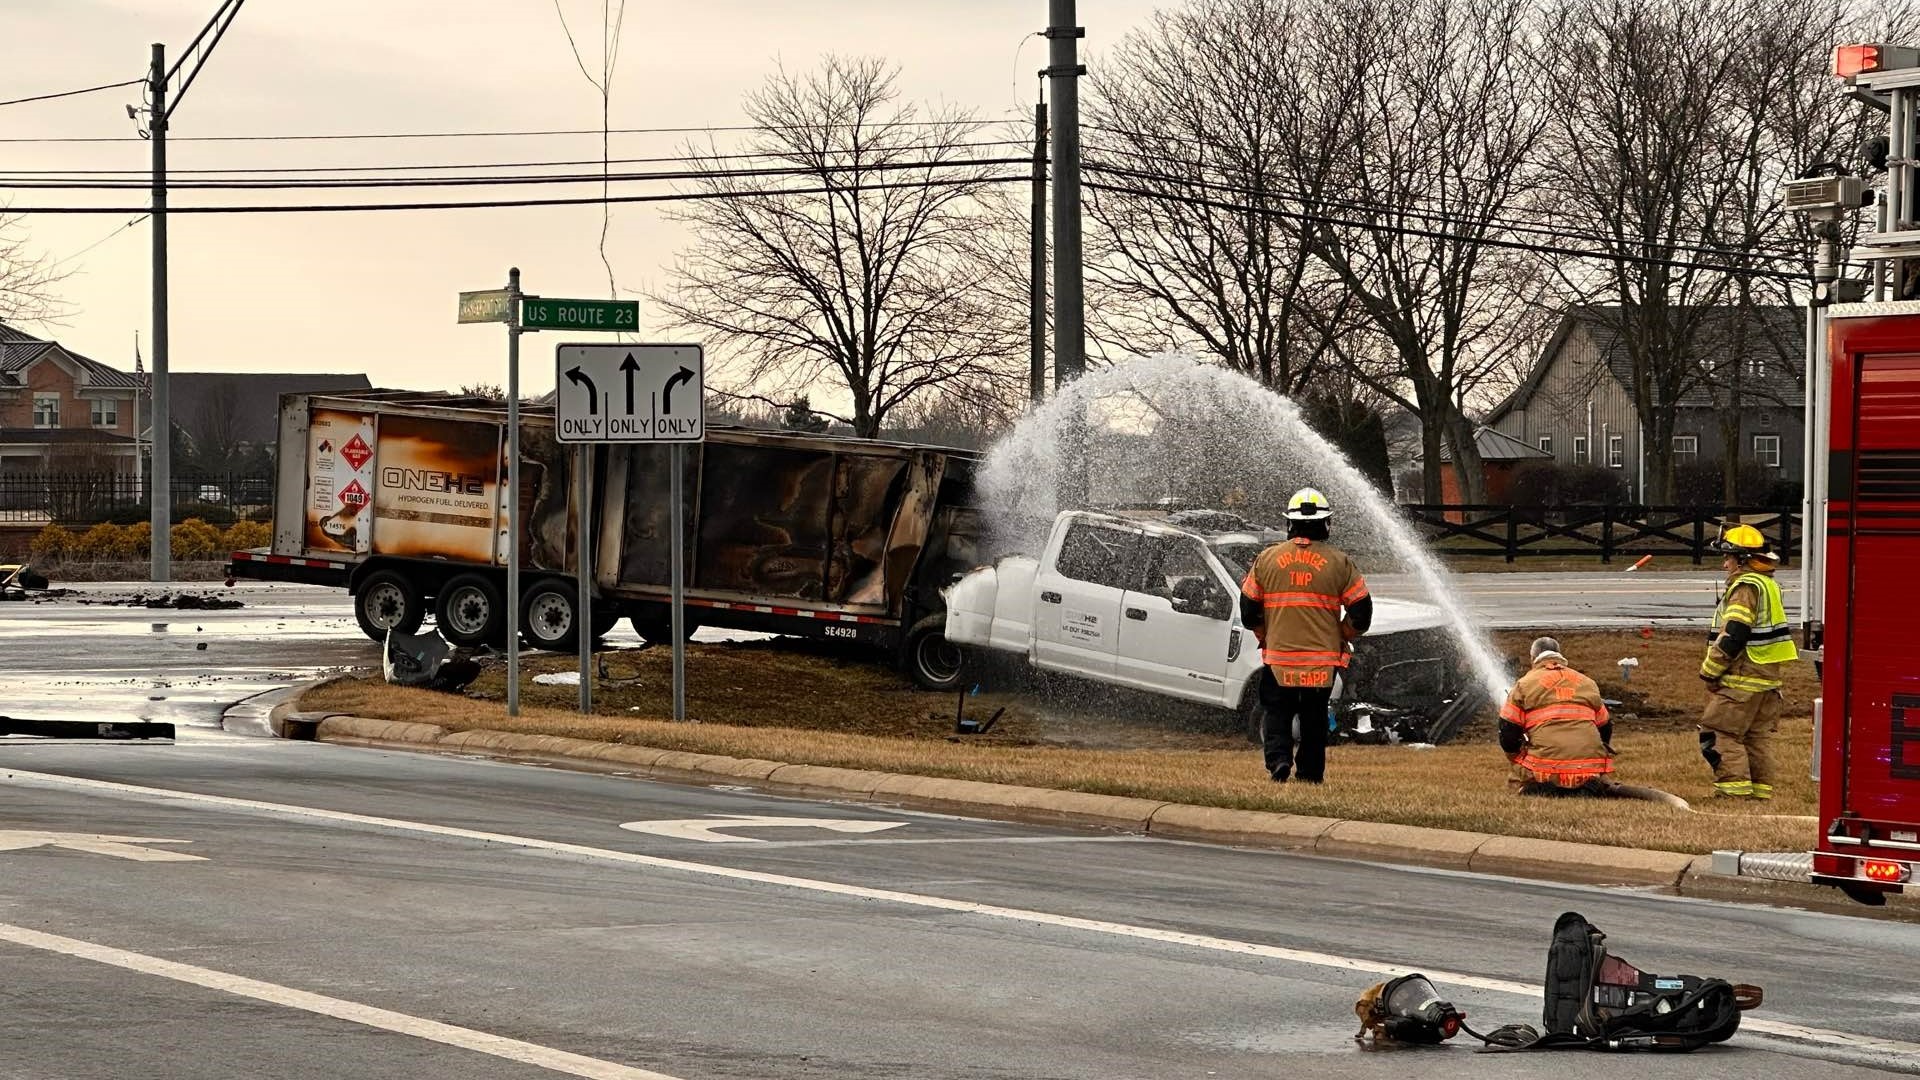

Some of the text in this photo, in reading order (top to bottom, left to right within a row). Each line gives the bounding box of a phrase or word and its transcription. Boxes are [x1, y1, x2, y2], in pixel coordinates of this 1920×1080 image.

[528, 306, 548, 322] US
[558, 307, 605, 325] ROUTE
[615, 309, 634, 324] 23
[563, 418, 602, 434] ONLY
[610, 418, 649, 434] ONLY
[658, 418, 697, 434] ONLY
[382, 467, 485, 496] ONEH2
[346, 493, 363, 504] 1049
[398, 495, 435, 505] HYDROGEN
[1276, 548, 1329, 573] ORANGE
[1288, 570, 1313, 587] TWP
